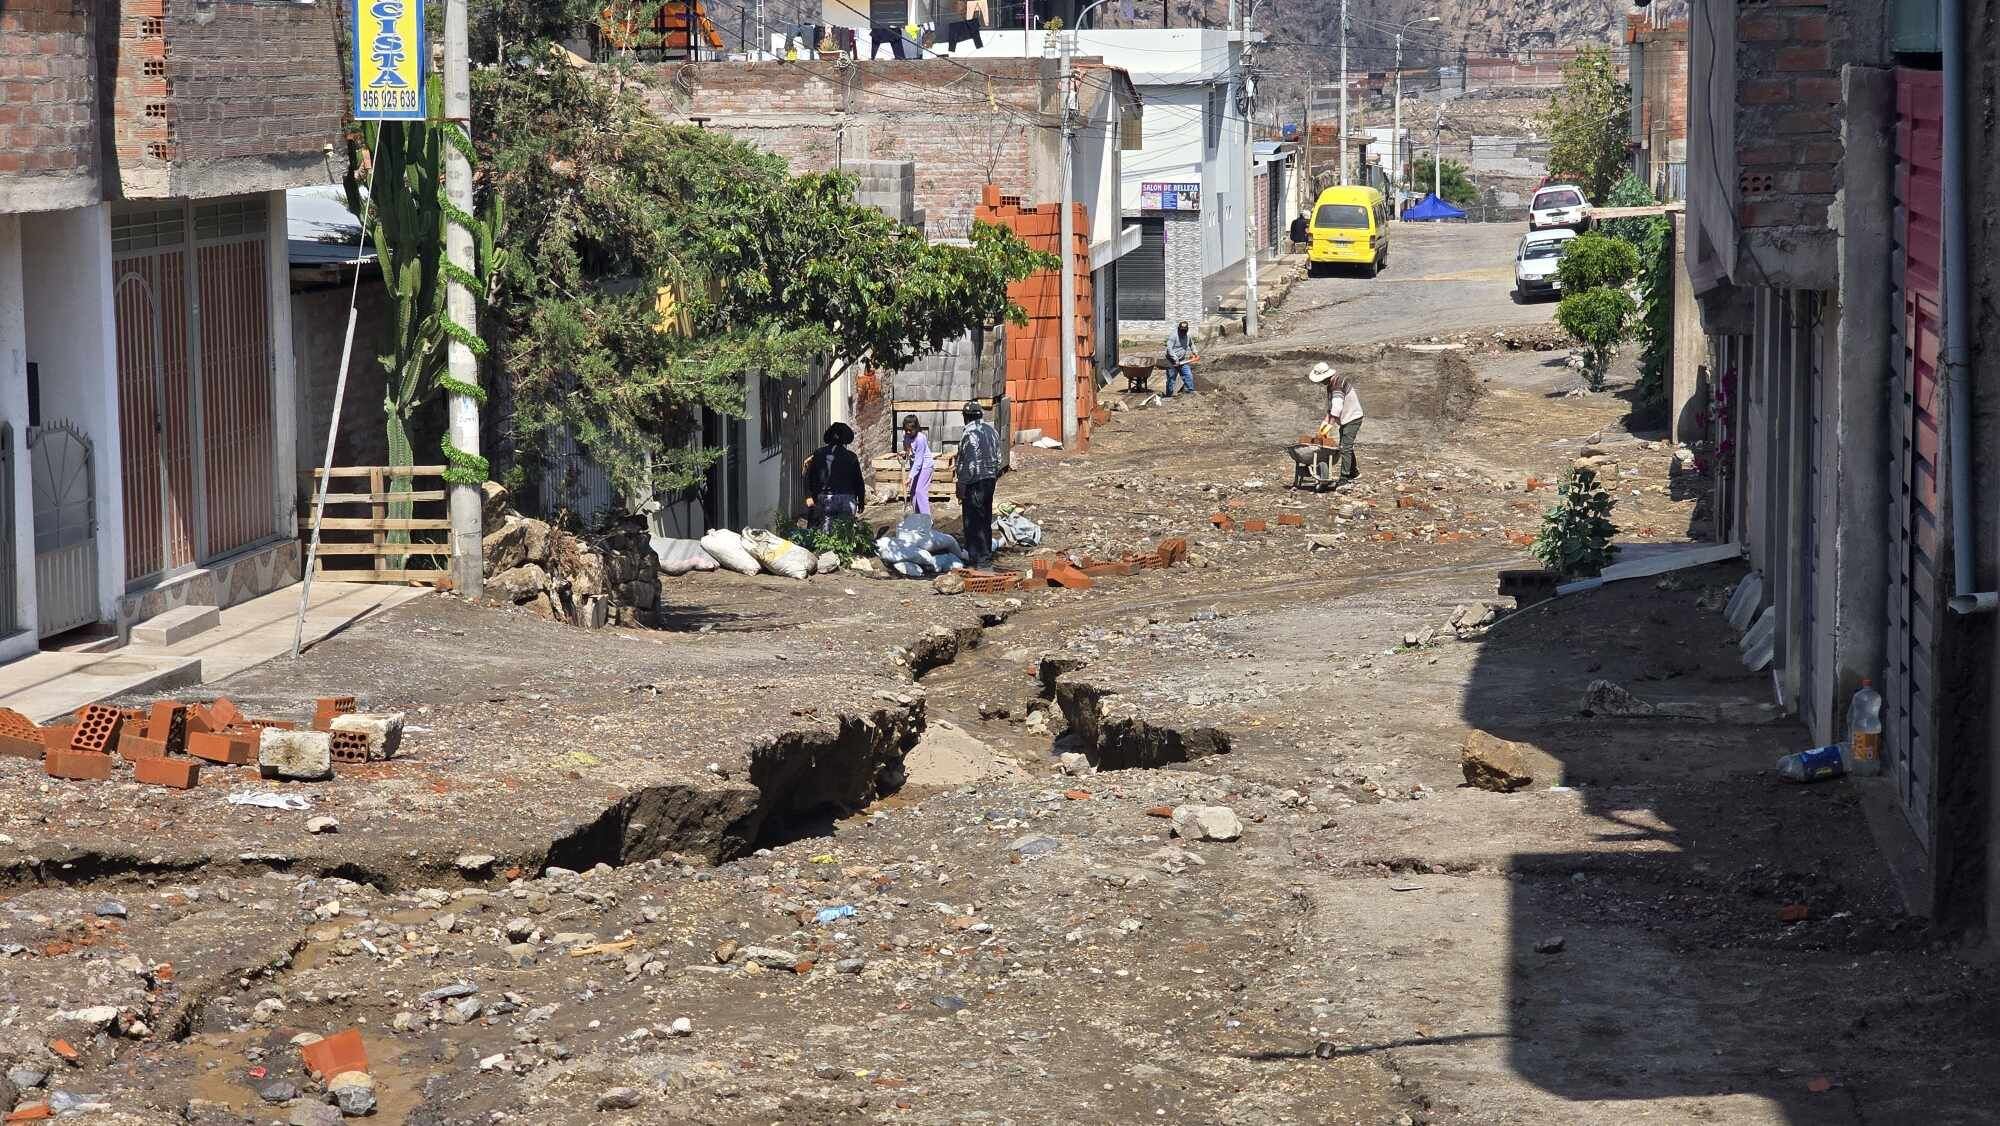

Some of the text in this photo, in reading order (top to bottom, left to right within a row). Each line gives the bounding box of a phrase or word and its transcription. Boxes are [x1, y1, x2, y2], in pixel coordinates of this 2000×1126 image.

[363, 90, 416, 107] 956 025 638
